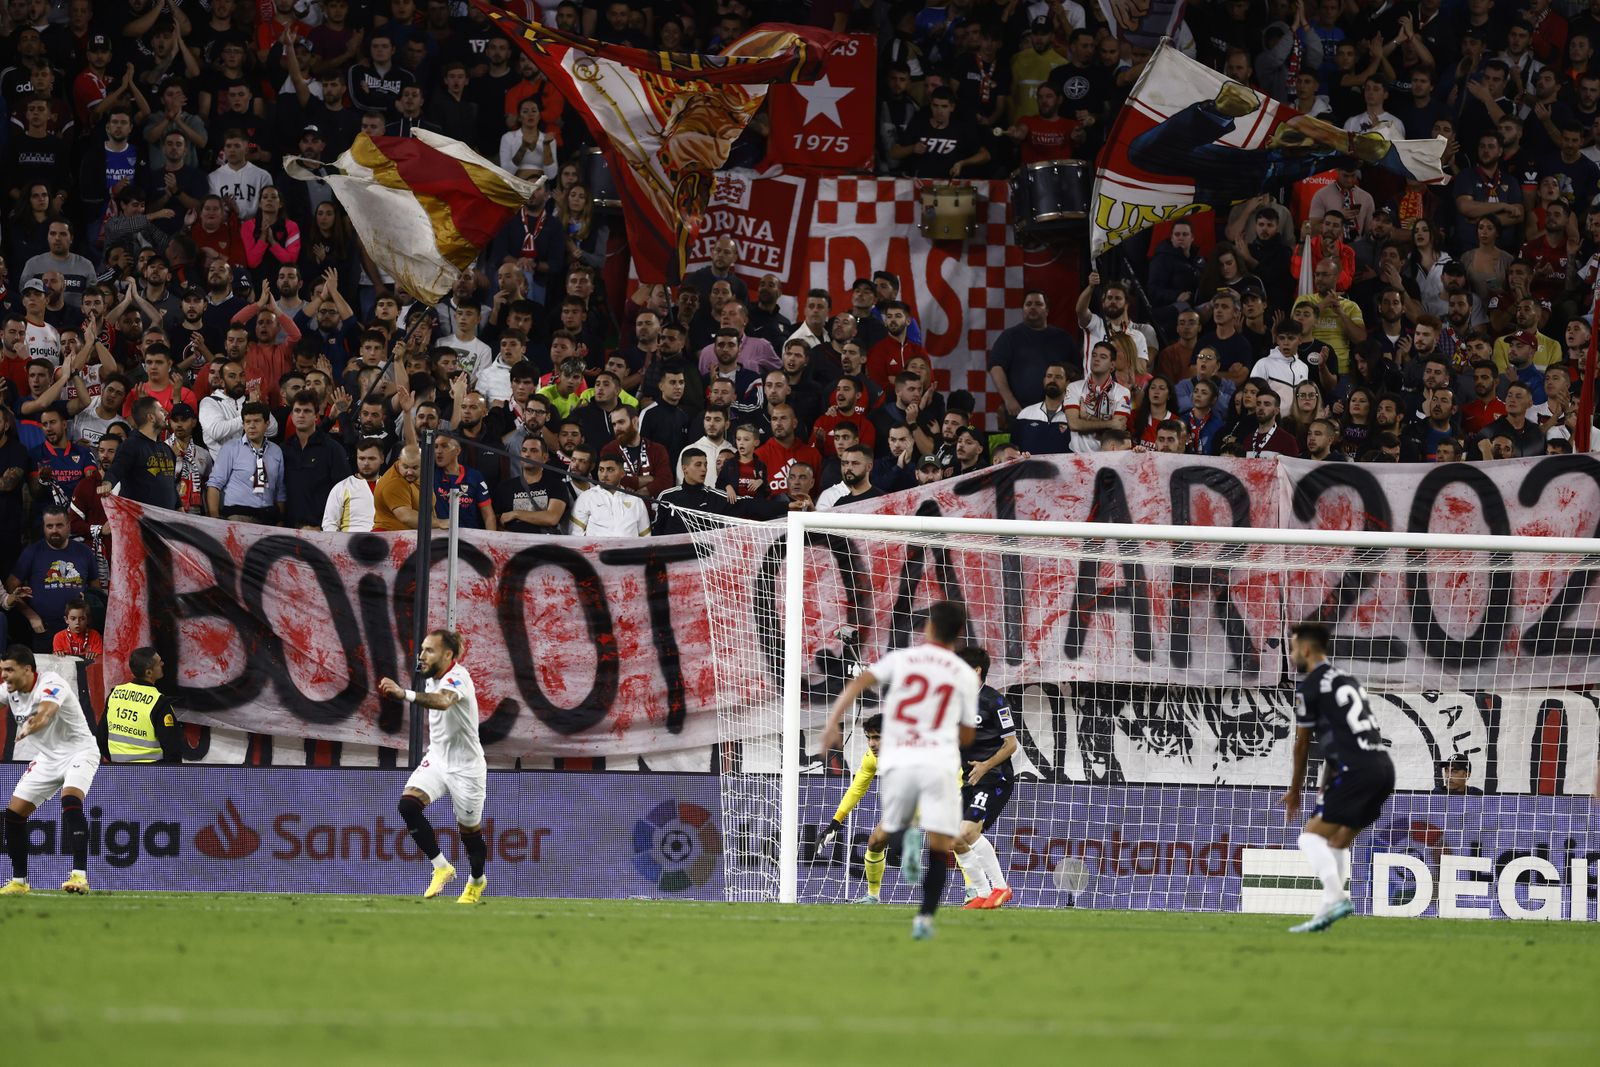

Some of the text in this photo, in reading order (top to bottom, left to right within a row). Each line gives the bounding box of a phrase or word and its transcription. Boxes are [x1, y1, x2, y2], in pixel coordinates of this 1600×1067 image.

[793, 133, 849, 152] 1975
[220, 183, 256, 201] GAP
[755, 460, 1262, 706] QATAR
[112, 689, 154, 705] SEGURIDAD
[895, 673, 956, 731] 21
[116, 707, 139, 722] 1575
[1010, 827, 1284, 877] Santand
[1373, 852, 1600, 921] DEGI
